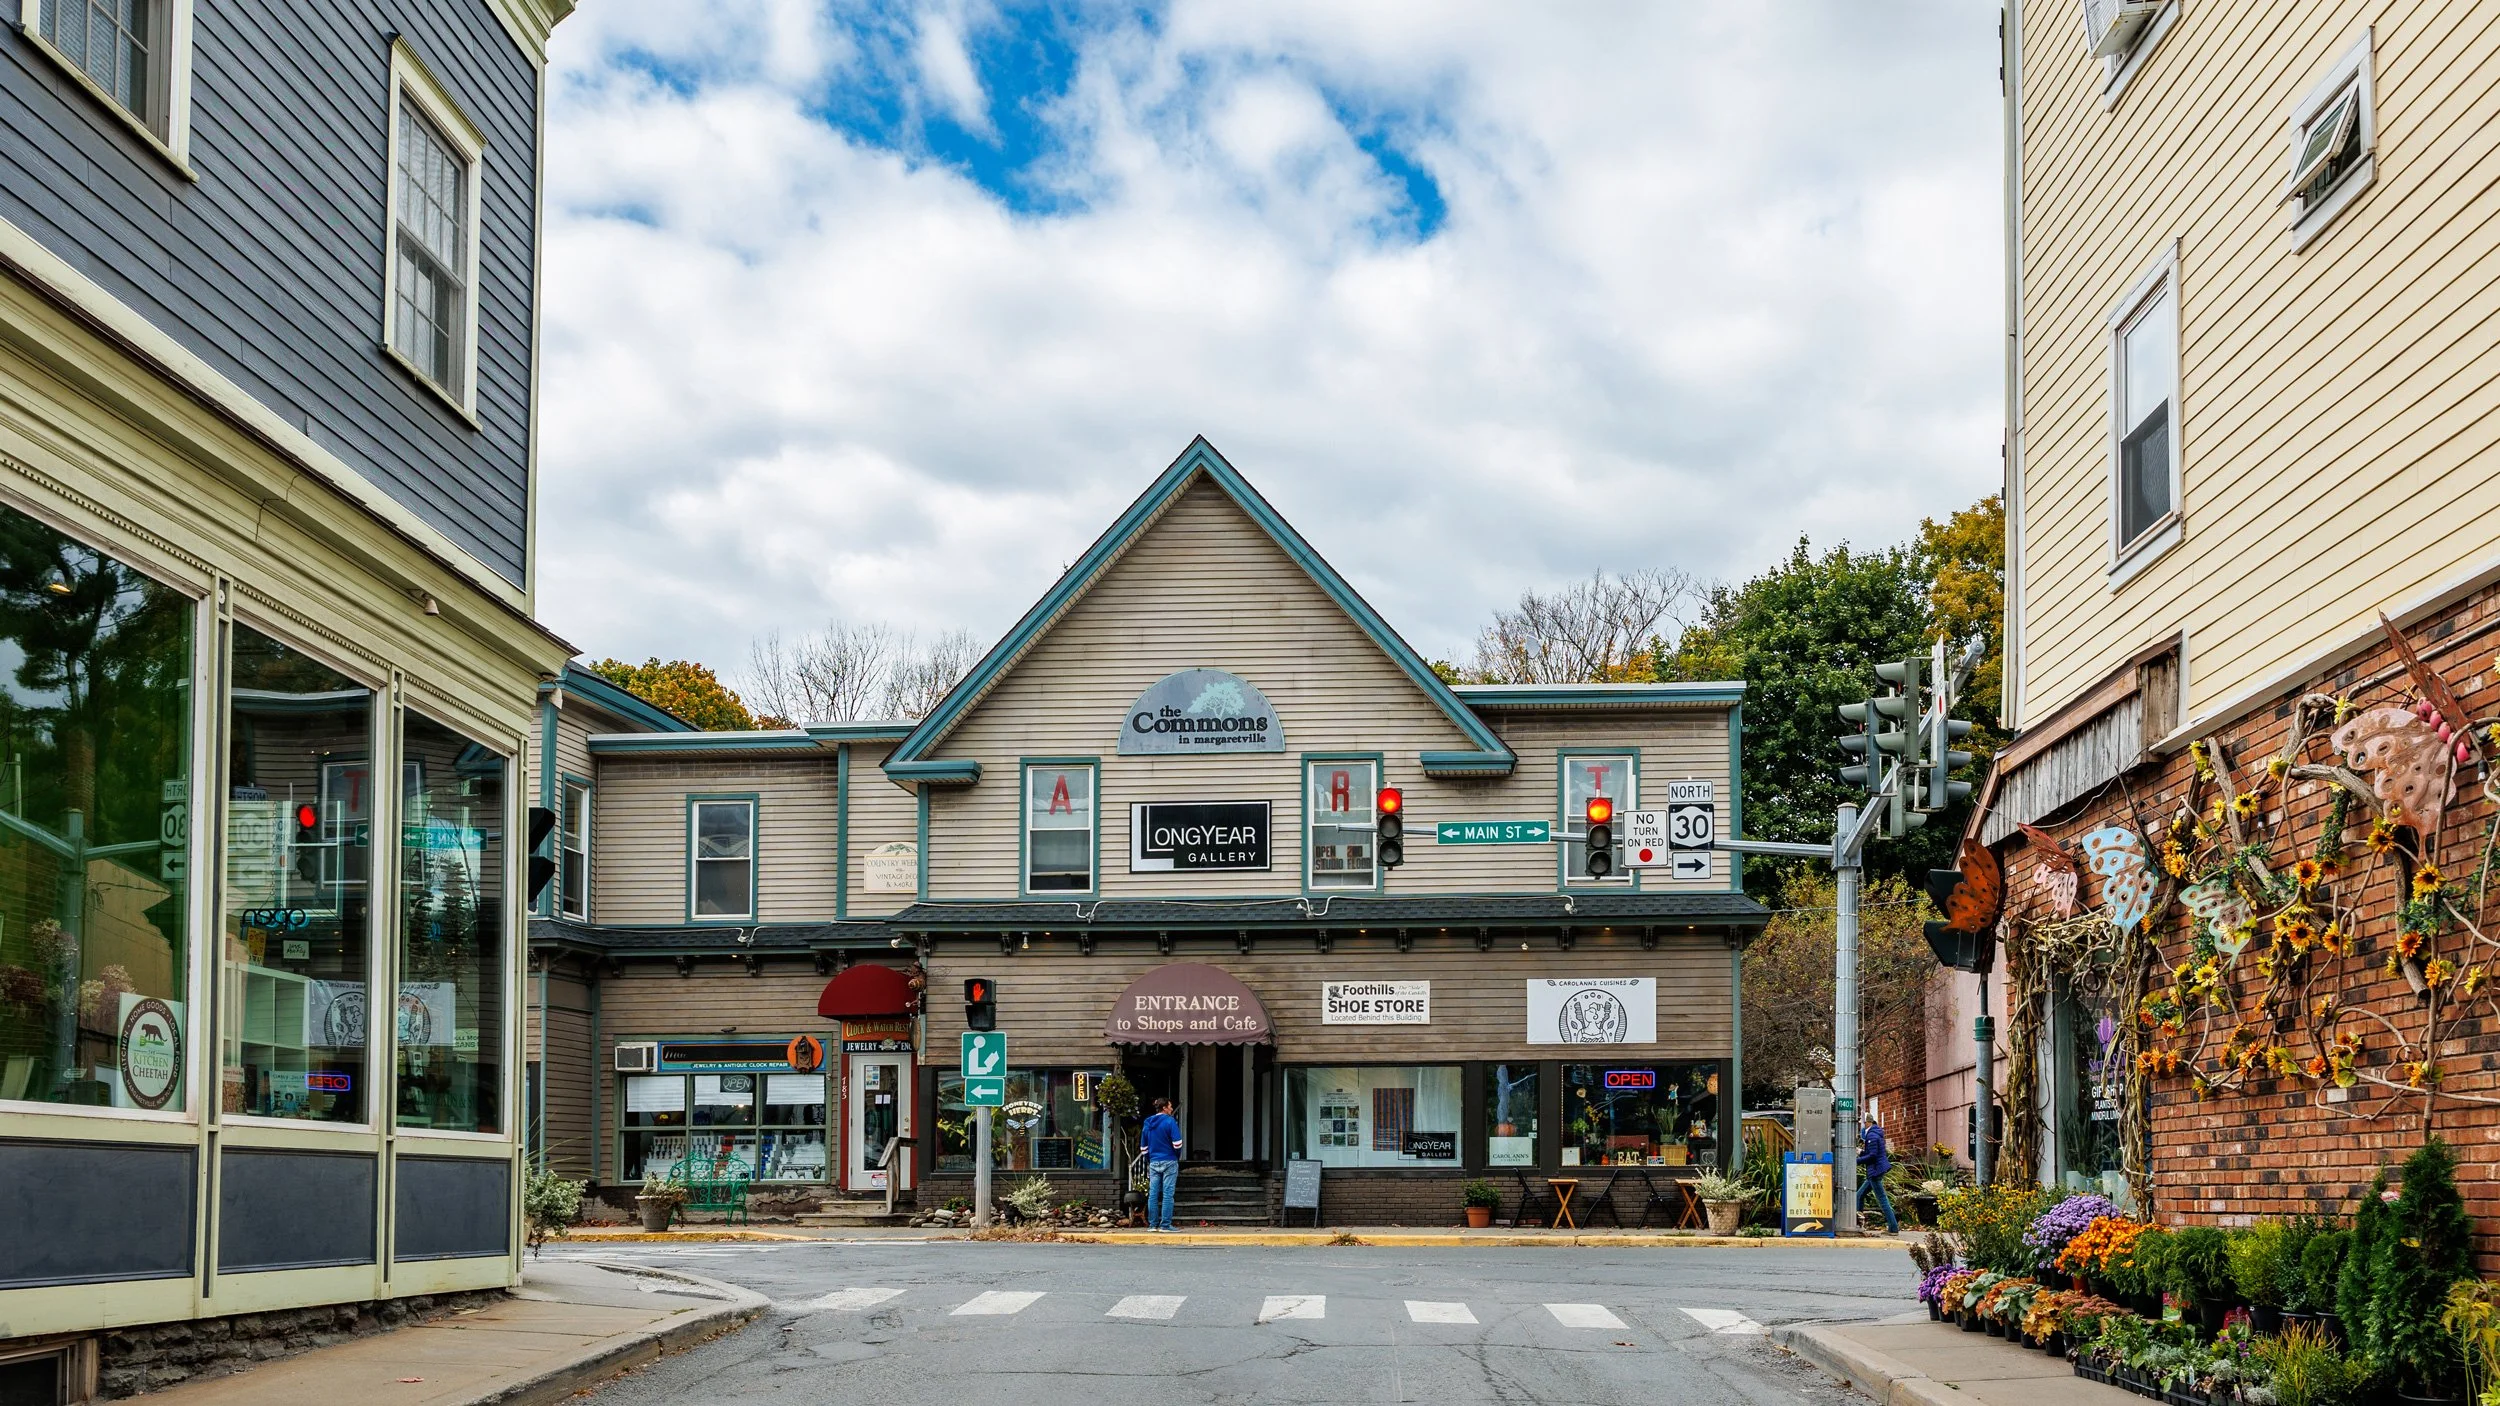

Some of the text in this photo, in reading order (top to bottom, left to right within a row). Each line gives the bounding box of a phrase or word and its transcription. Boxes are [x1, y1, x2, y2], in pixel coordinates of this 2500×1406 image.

[1160, 705, 1181, 717] the
[1132, 712, 1268, 733] Commons
[1179, 733, 1267, 745] in margaretville
[1587, 767, 1609, 797] T
[1049, 775, 1072, 815] A
[1332, 770, 1349, 812] R
[1671, 785, 1710, 798] NORTH
[1636, 814, 1654, 824] NO
[1465, 826, 1522, 839] MAIN ST
[1633, 827, 1658, 835] TURN
[1675, 814, 1709, 839] 30
[1628, 838, 1664, 847] ON RED
[1188, 852, 1256, 862] GALLERY
[1342, 984, 1395, 995] Foothills
[1134, 996, 1240, 1010] ENTRANCE
[1328, 1000, 1425, 1013] SHOE STORE
[129, 1001, 167, 1023] HOME GOODS
[1396, 1013, 1422, 1022] Building
[846, 1022, 865, 1037] CLOCK
[866, 1023, 872, 1033] &
[873, 1021, 894, 1032] WATCH
[1117, 1016, 1257, 1032] to Shops and Cafe
[168, 1018, 179, 1048] LOCAL
[121, 1030, 129, 1072] KITCHEN
[846, 1042, 878, 1051] JEWELRY
[133, 1053, 169, 1068] KITCHEN
[132, 1065, 168, 1080] CHEETAH
[723, 1078, 751, 1089] OPEN
[1607, 1073, 1652, 1086] OPEN
[2091, 1083, 2124, 1098] GIF SHP
[1002, 1101, 1043, 1111] HONEYBEE
[1008, 1106, 1039, 1116] HERBS
[1076, 1148, 1102, 1164] Herbs
[1618, 1151, 1640, 1164] EAT
[1798, 1191, 1821, 1199] luxury
[1790, 1208, 1830, 1216] mercantile
